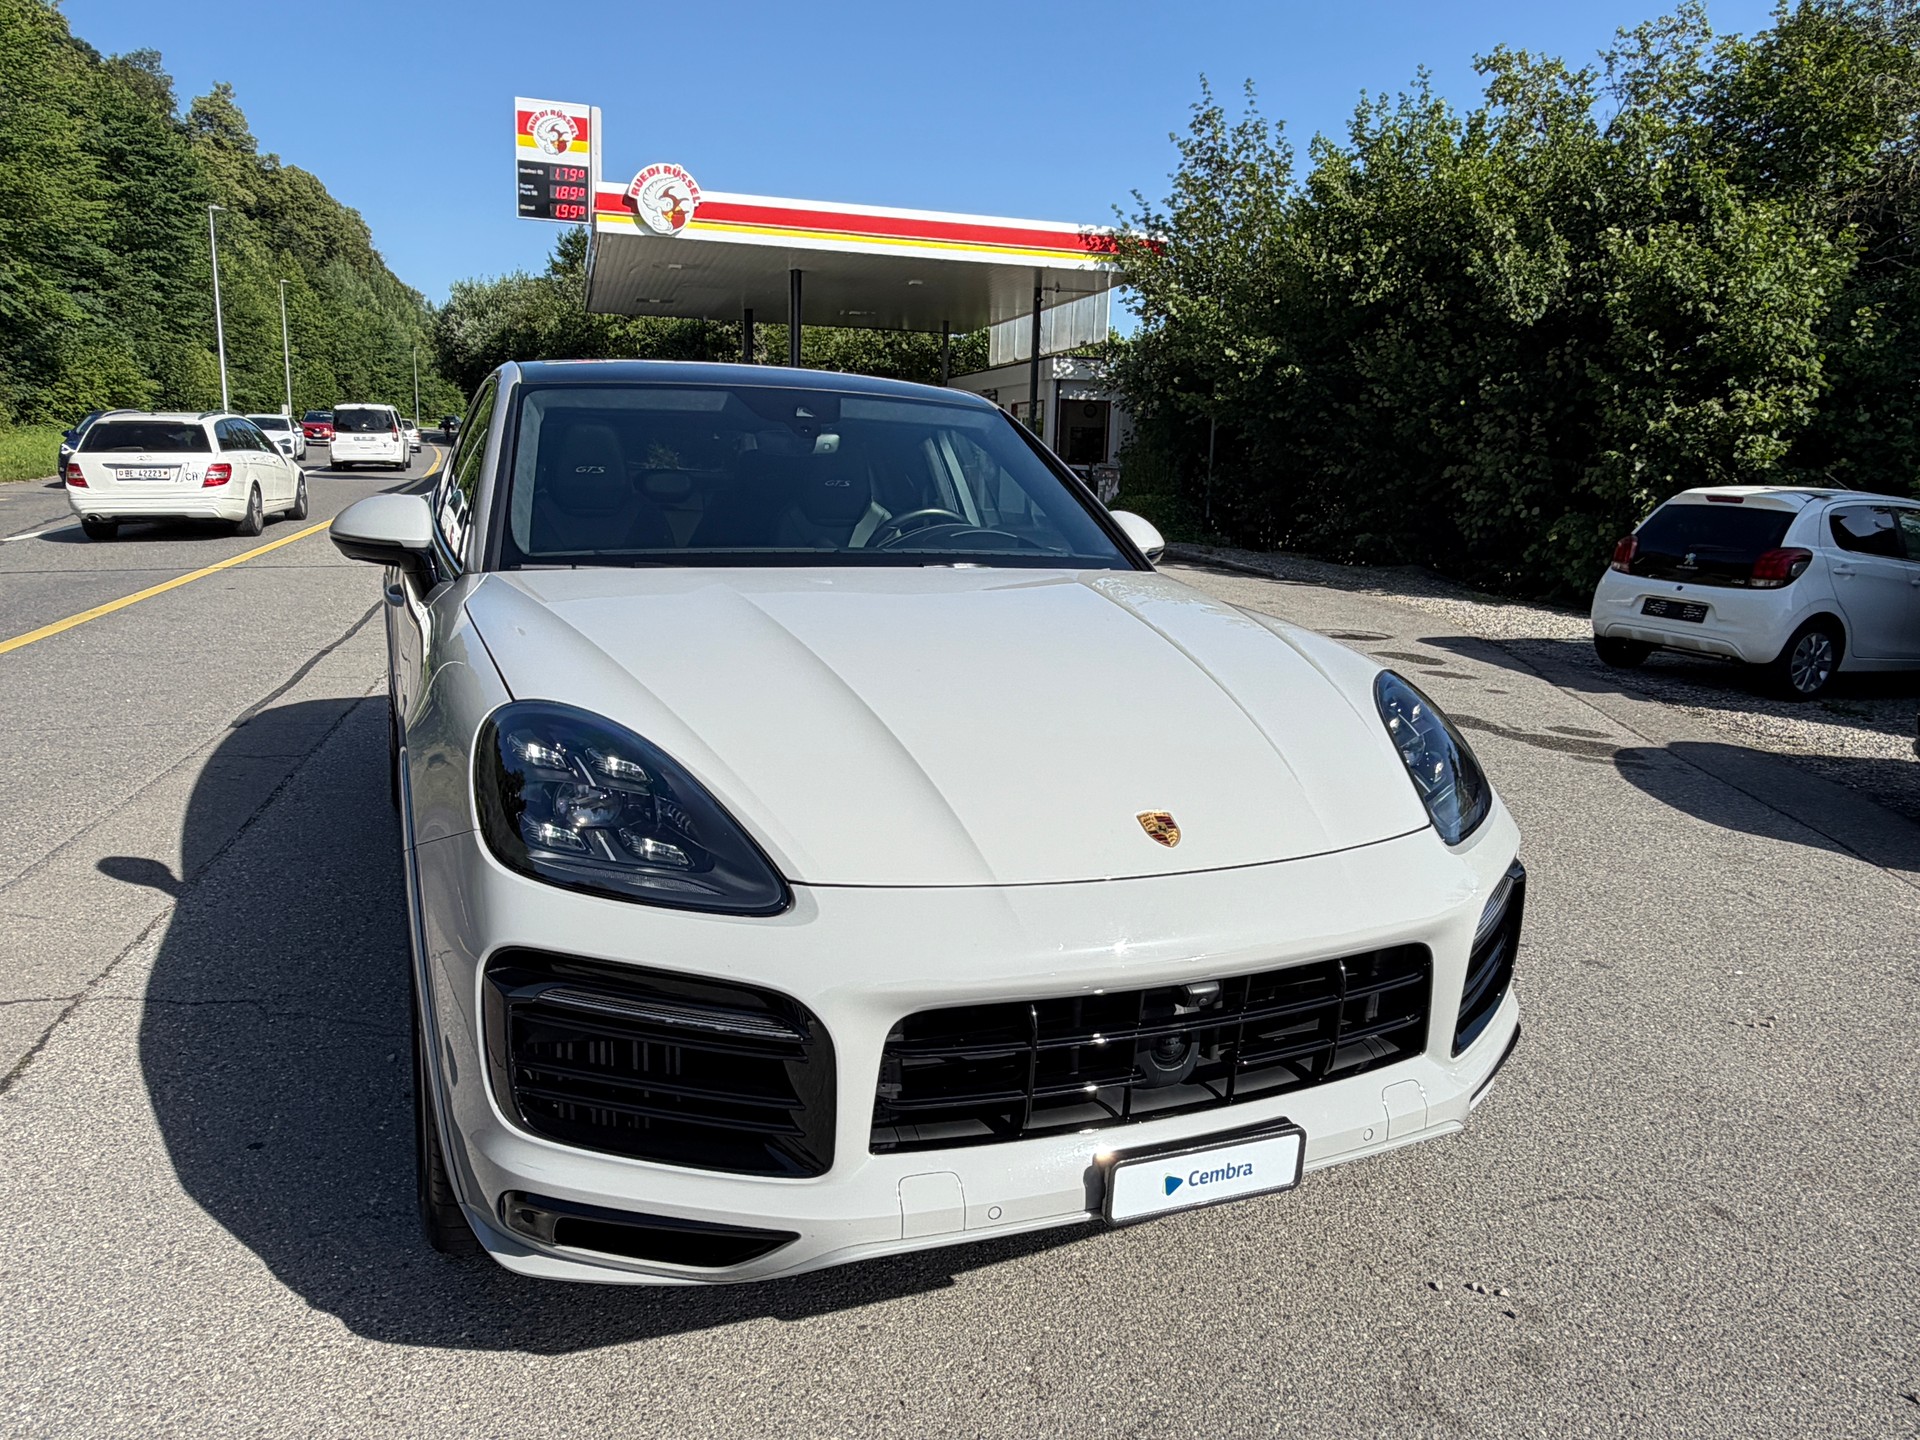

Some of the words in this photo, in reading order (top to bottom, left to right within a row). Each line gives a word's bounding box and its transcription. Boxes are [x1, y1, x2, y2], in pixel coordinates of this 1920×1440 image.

[529, 110, 548, 131] RUEDI
[631, 166, 660, 196] RUEDI
[663, 165, 701, 204] RÜSSEL
[1188, 1162, 1253, 1187] Cembra
